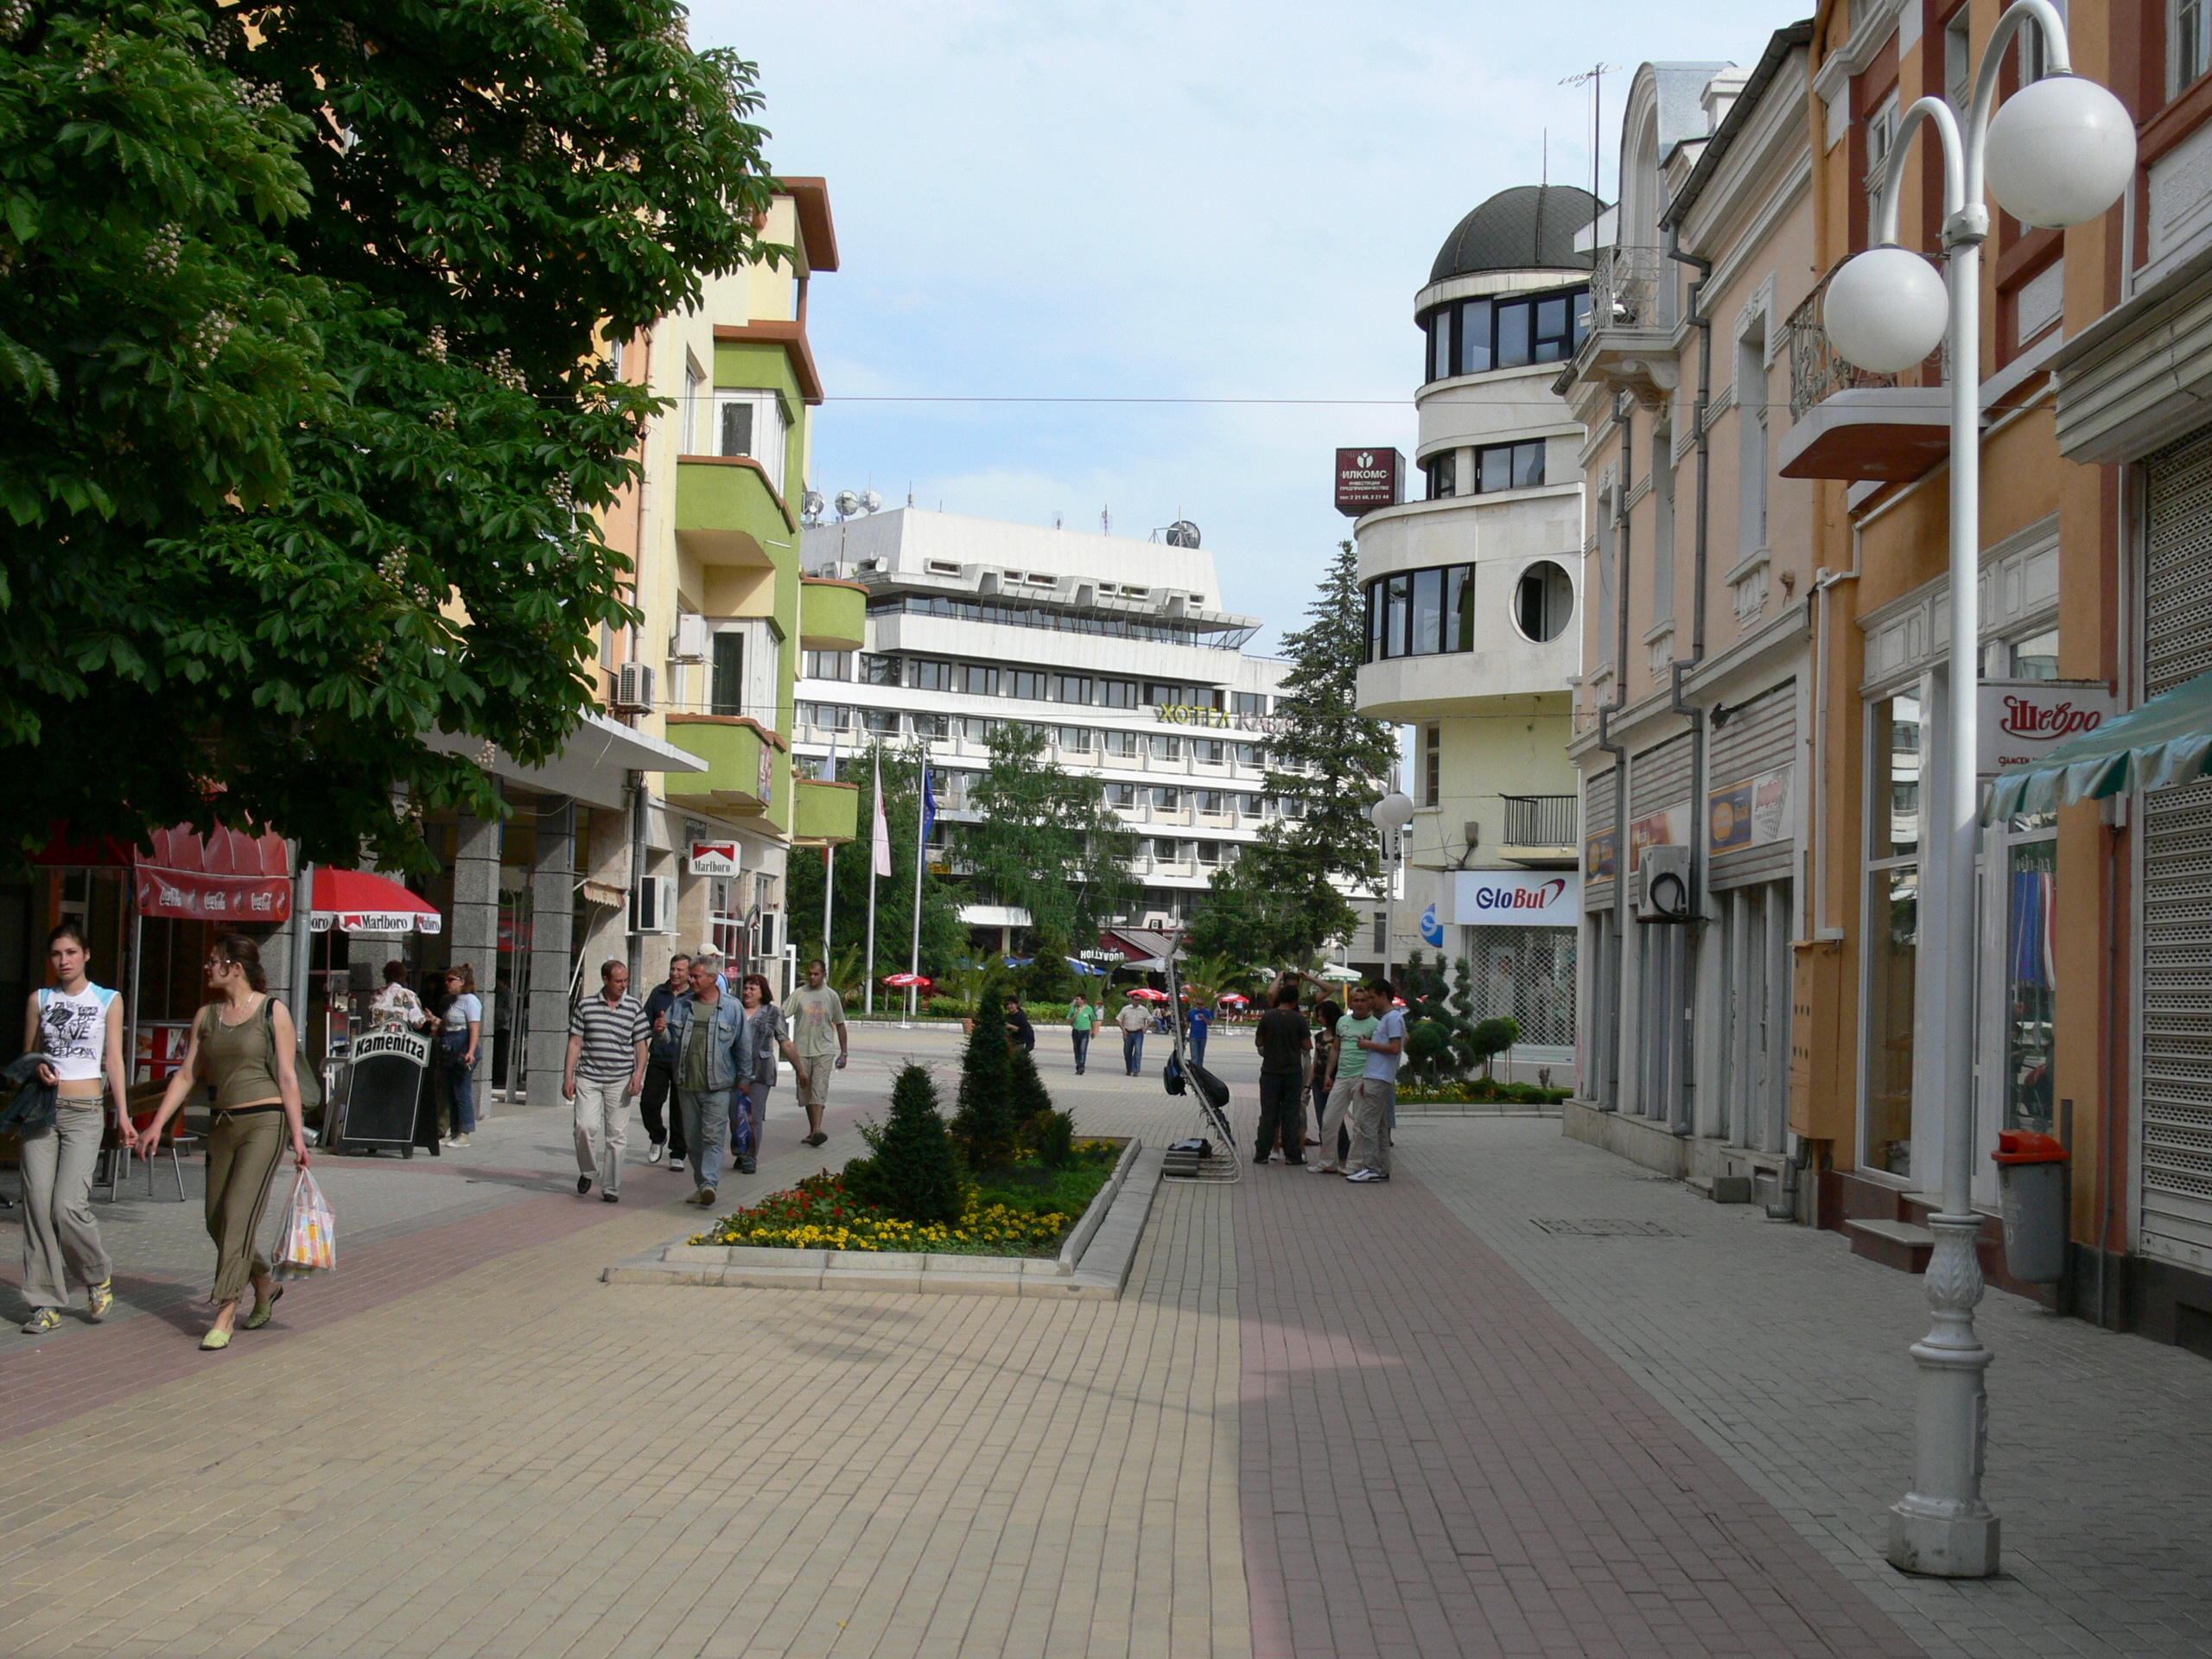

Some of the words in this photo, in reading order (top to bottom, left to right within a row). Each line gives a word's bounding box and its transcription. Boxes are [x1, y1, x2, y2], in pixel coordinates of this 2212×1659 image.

[1342, 470, 1387, 479] ИЛКОМС
[1160, 702, 1233, 729] ХОТЕЛ
[2000, 695, 2102, 741] Шевро
[694, 861, 731, 873] Marlboro
[362, 914, 408, 930] Marlboro
[355, 1034, 425, 1061] Kamenitza
